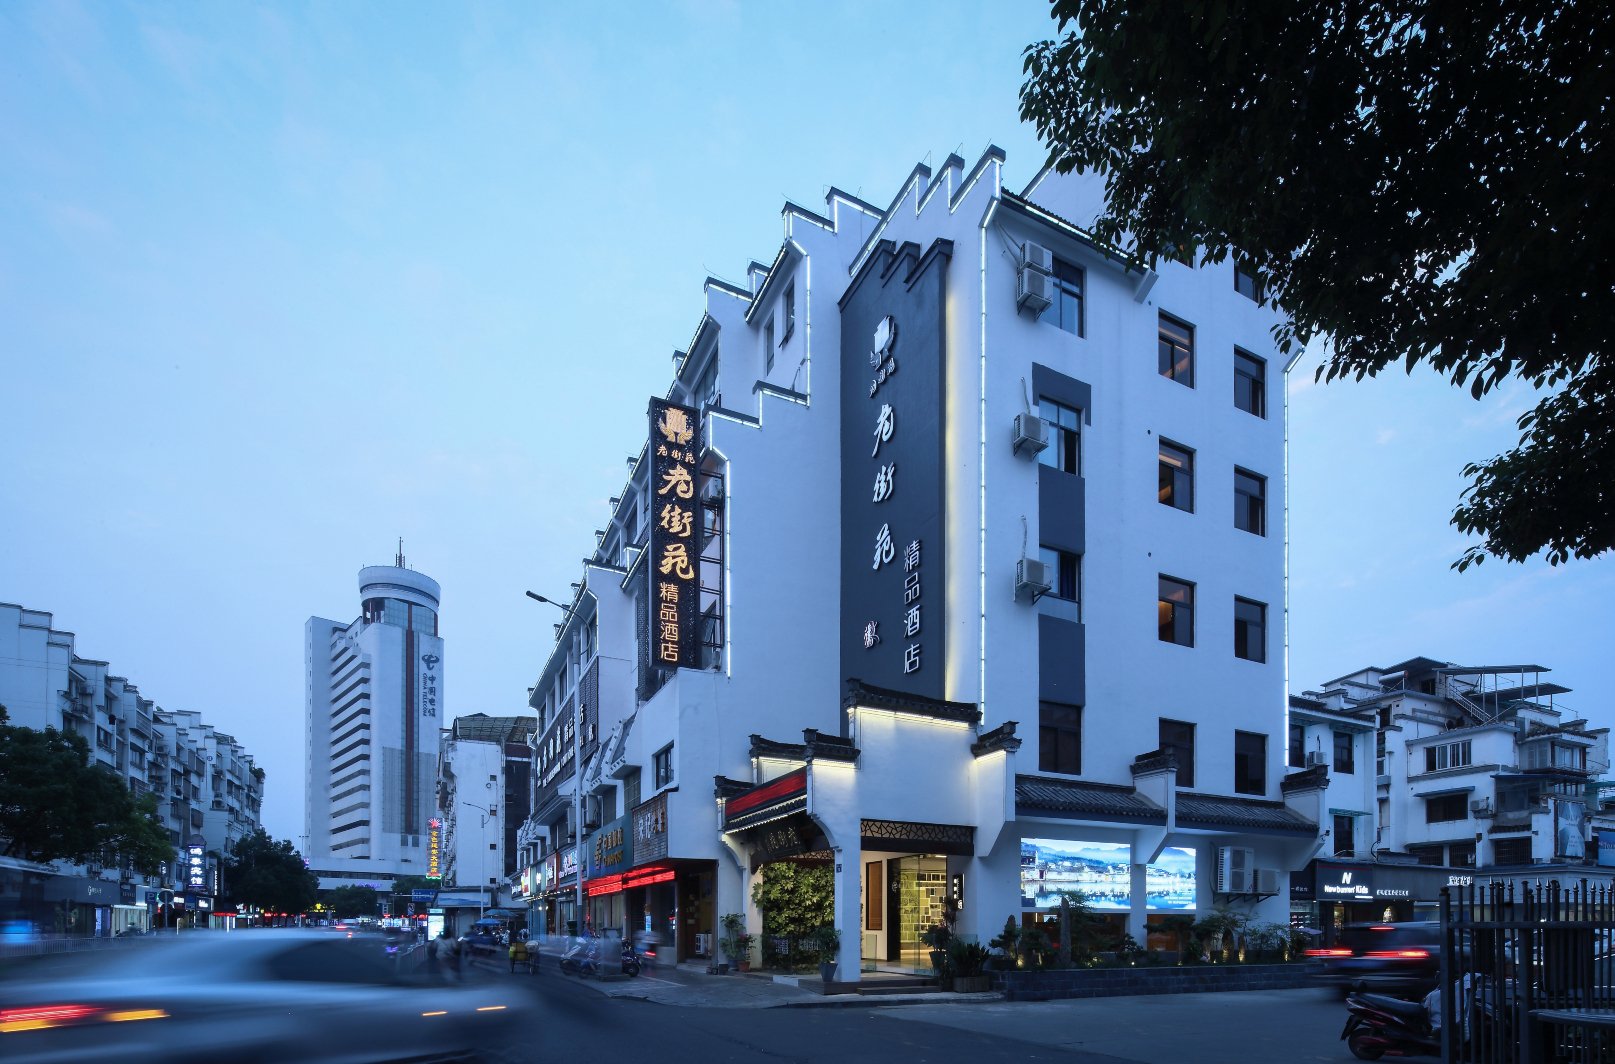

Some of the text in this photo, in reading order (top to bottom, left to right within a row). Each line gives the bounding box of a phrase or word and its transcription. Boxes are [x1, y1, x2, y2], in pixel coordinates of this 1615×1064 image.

[658, 464, 694, 579] 老街苑
[872, 403, 894, 570] 老街苑
[660, 582, 679, 662] 精品酒店
[904, 540, 920, 674] 精品酒店
[1356, 885, 1368, 894] Kids
